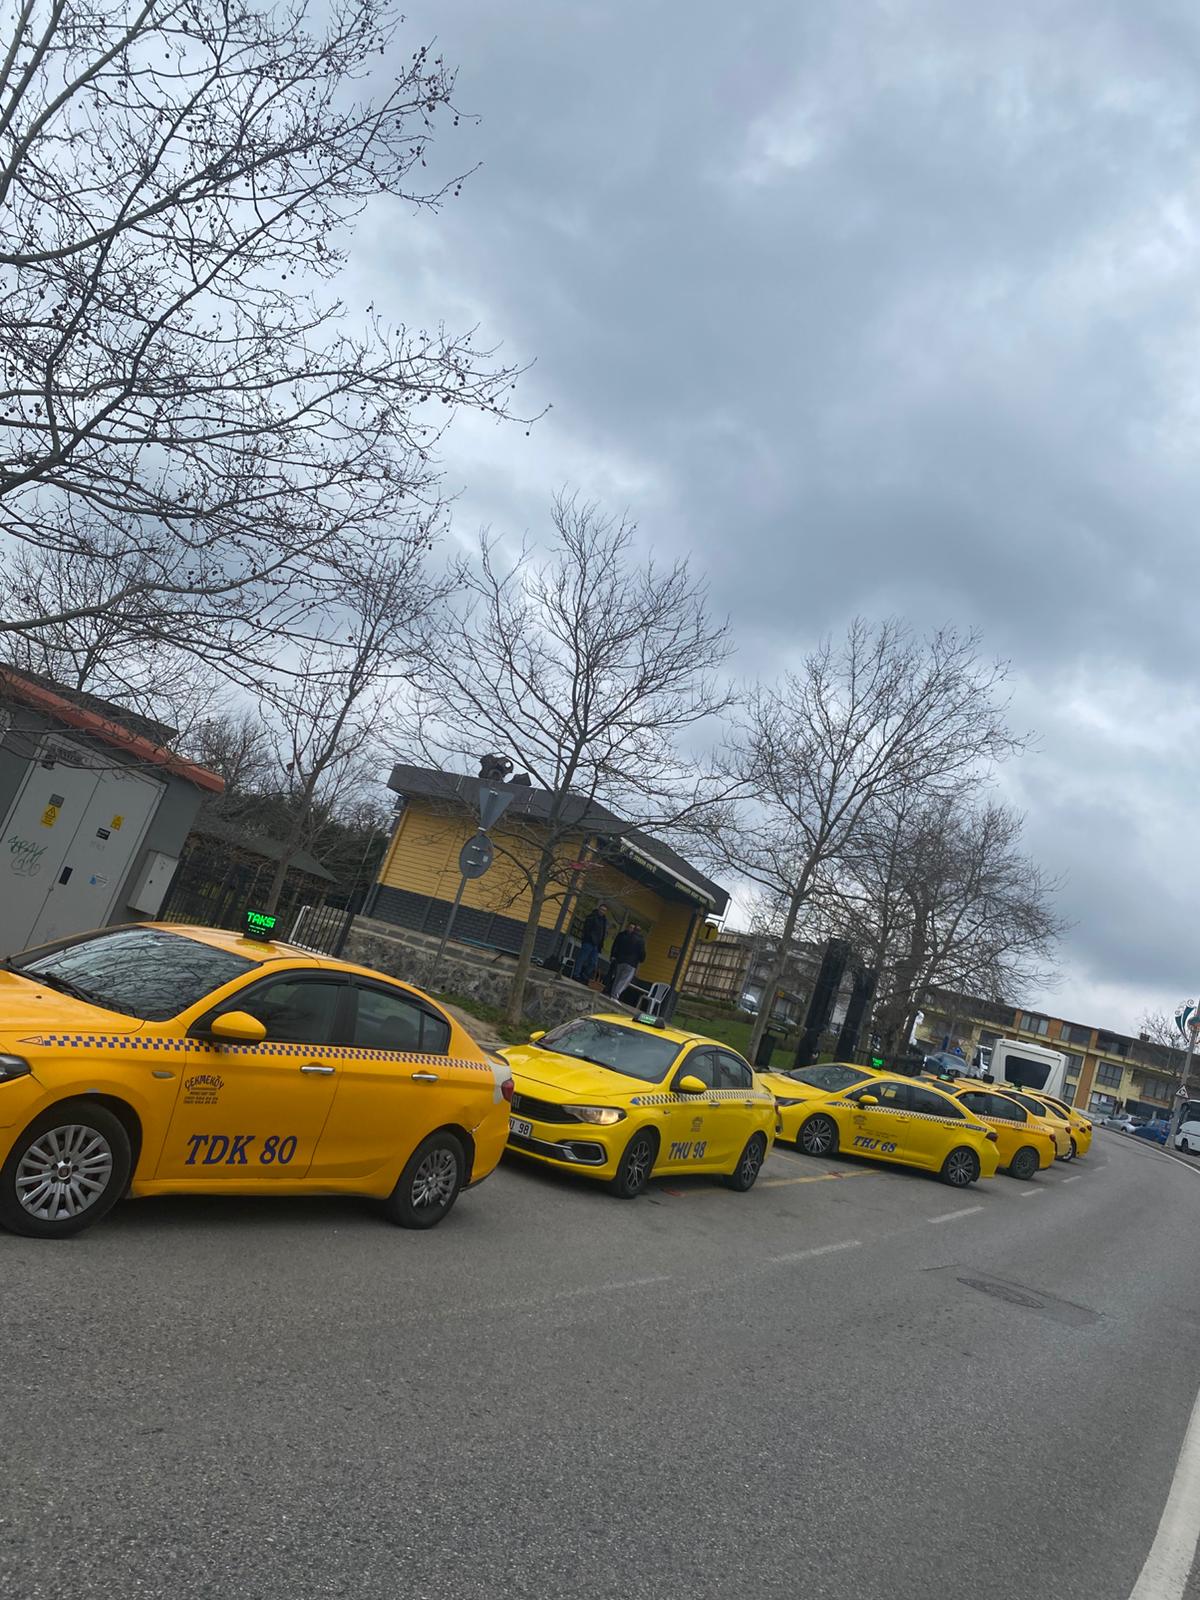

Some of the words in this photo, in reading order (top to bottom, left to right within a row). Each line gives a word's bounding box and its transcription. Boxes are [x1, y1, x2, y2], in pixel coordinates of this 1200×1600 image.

[518, 1123, 530, 1135] 98
[184, 1134, 256, 1165] TDK
[259, 1135, 298, 1165] 80
[668, 1141, 693, 1160] THU
[692, 1140, 707, 1158] 98
